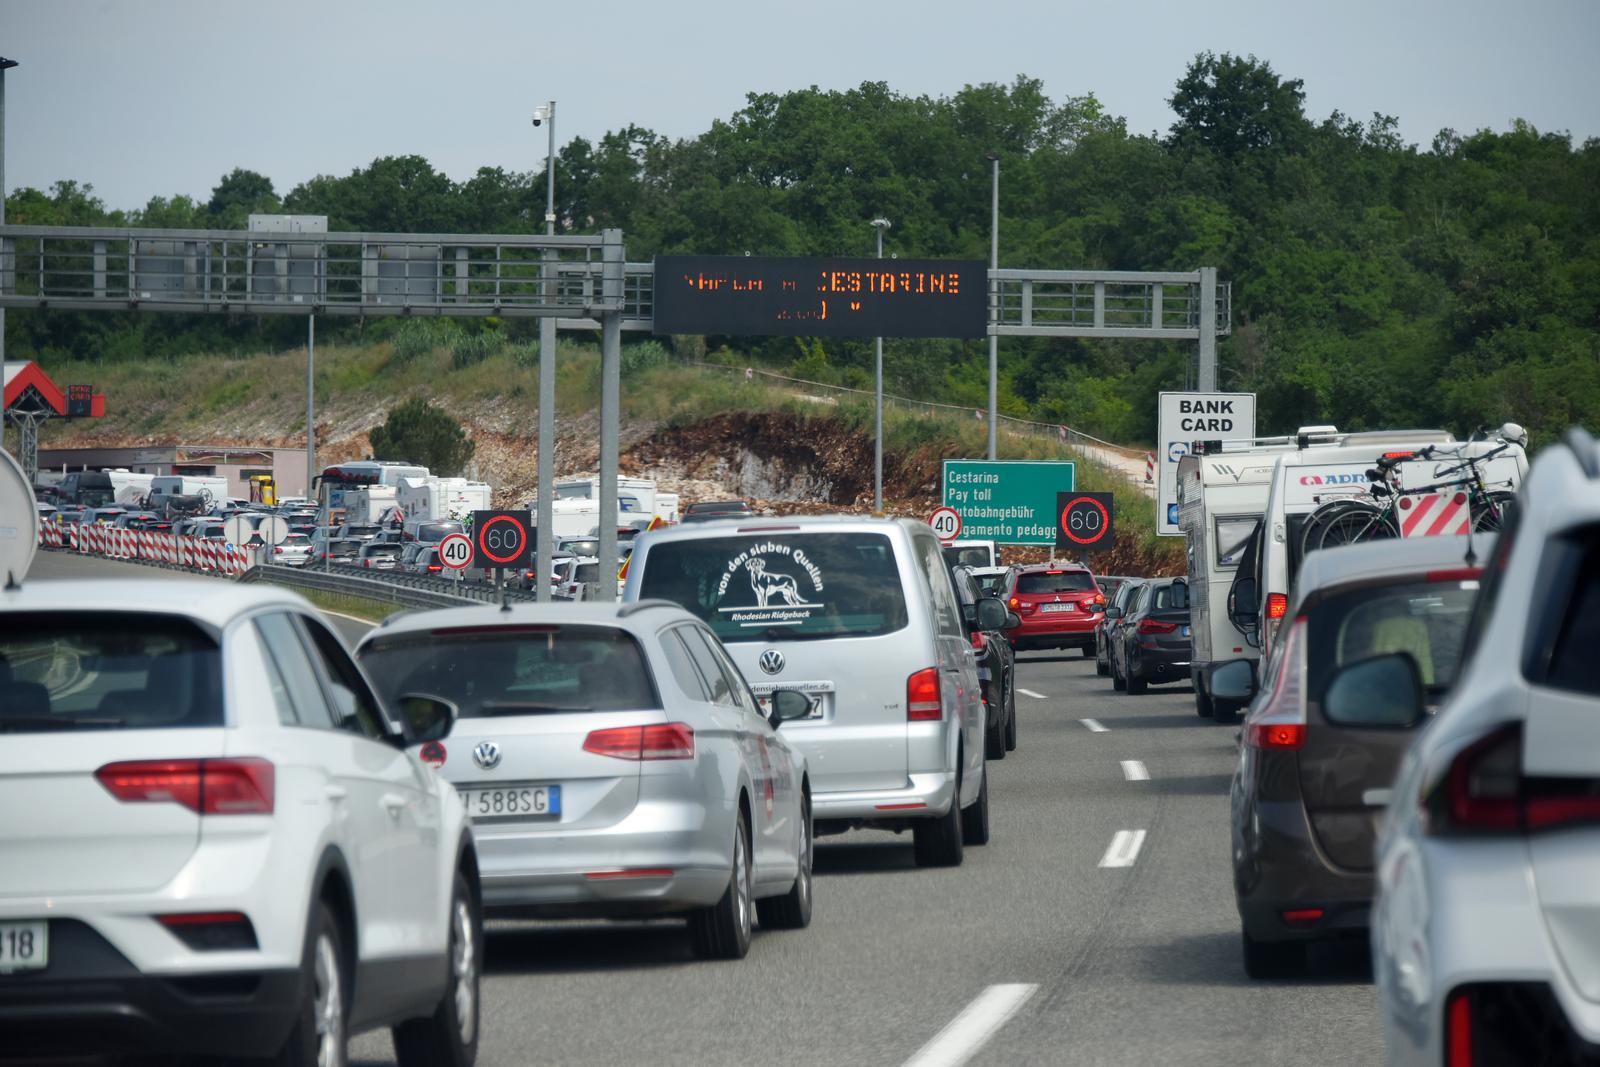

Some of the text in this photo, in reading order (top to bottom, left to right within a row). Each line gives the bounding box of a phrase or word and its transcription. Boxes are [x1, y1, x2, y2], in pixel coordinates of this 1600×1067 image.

[1180, 400, 1234, 414] BANK
[1181, 418, 1233, 432] CARD
[949, 471, 999, 484] Cestarina
[1325, 473, 1372, 485] ADR
[949, 489, 992, 502] Pay toll
[934, 516, 954, 533] 40
[1070, 510, 1099, 530] 60
[488, 529, 517, 548] 60
[959, 524, 1012, 538] gamento
[445, 543, 467, 560] 40
[718, 572, 731, 595] von
[728, 552, 749, 572] den
[792, 549, 824, 592] Quellen
[731, 610, 811, 622] Rhodesian Ridgeback
[479, 790, 546, 813] 588SG
[0, 929, 34, 959] 18
